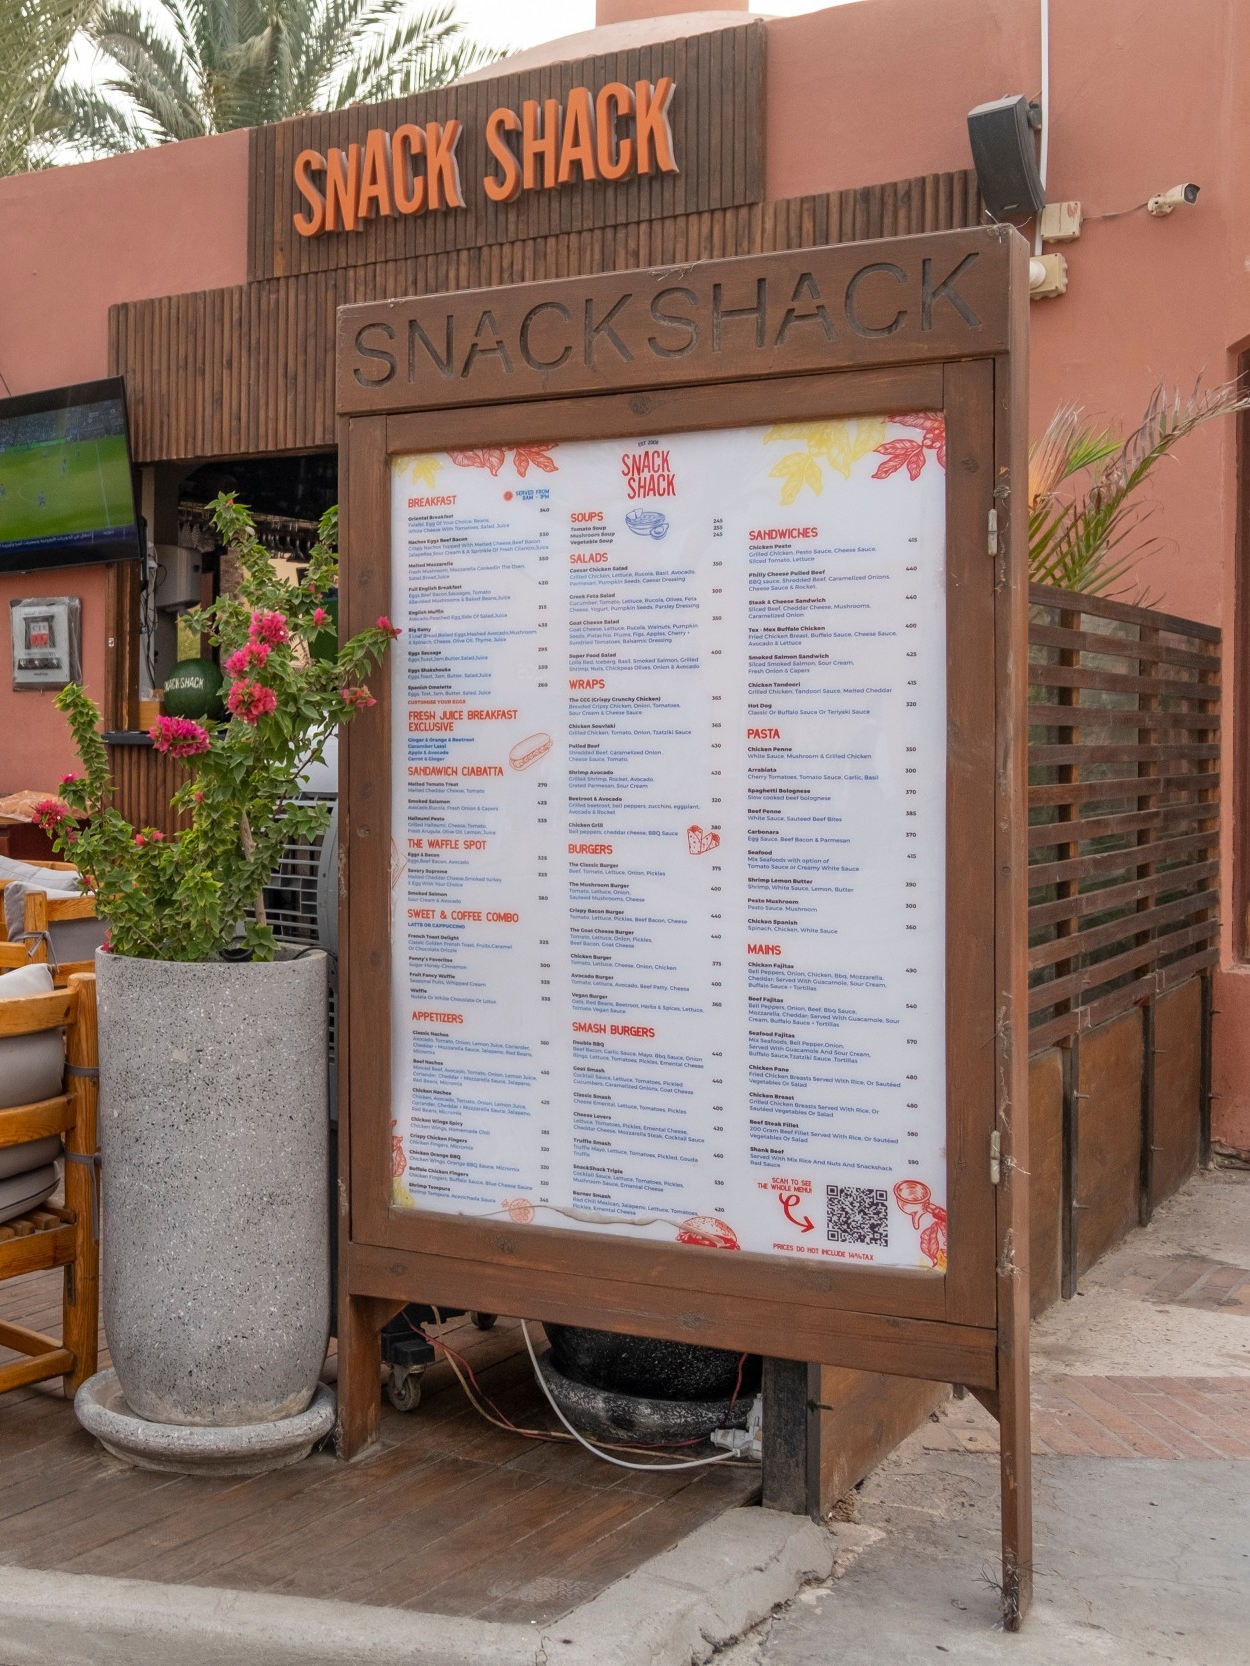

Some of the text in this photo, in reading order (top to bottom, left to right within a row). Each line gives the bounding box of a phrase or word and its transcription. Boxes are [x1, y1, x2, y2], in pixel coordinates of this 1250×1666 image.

[293, 76, 680, 238] SNACK SHACK
[353, 252, 982, 388] SNACKSHACK
[622, 450, 670, 477] SNACK
[627, 473, 676, 499] SHACK
[408, 495, 457, 508] BREAKFAST
[571, 512, 603, 523] SOUPS
[749, 527, 818, 540] SANDWICHES
[570, 552, 608, 564] SALADS
[569, 679, 605, 689] WRAPS
[409, 710, 518, 721] FRESH JUICE BREAKFAST
[409, 721, 454, 732] EXCLUSIVE
[747, 729, 780, 739] PASTA
[408, 766, 503, 776] SANDAWICH CIABATTA
[408, 839, 486, 850] THE WAFFLE SPOT
[568, 844, 613, 854] BURGERS
[408, 909, 519, 922] SWEET & COFFEE COMBO
[748, 944, 781, 955] MAINS
[412, 1011, 463, 1023] APPETIZERS
[572, 1022, 655, 1038] SMASH BURGERS
[771, 1183, 791, 1192] WHOLE
[822, 1249, 846, 1257] INCLUDE
